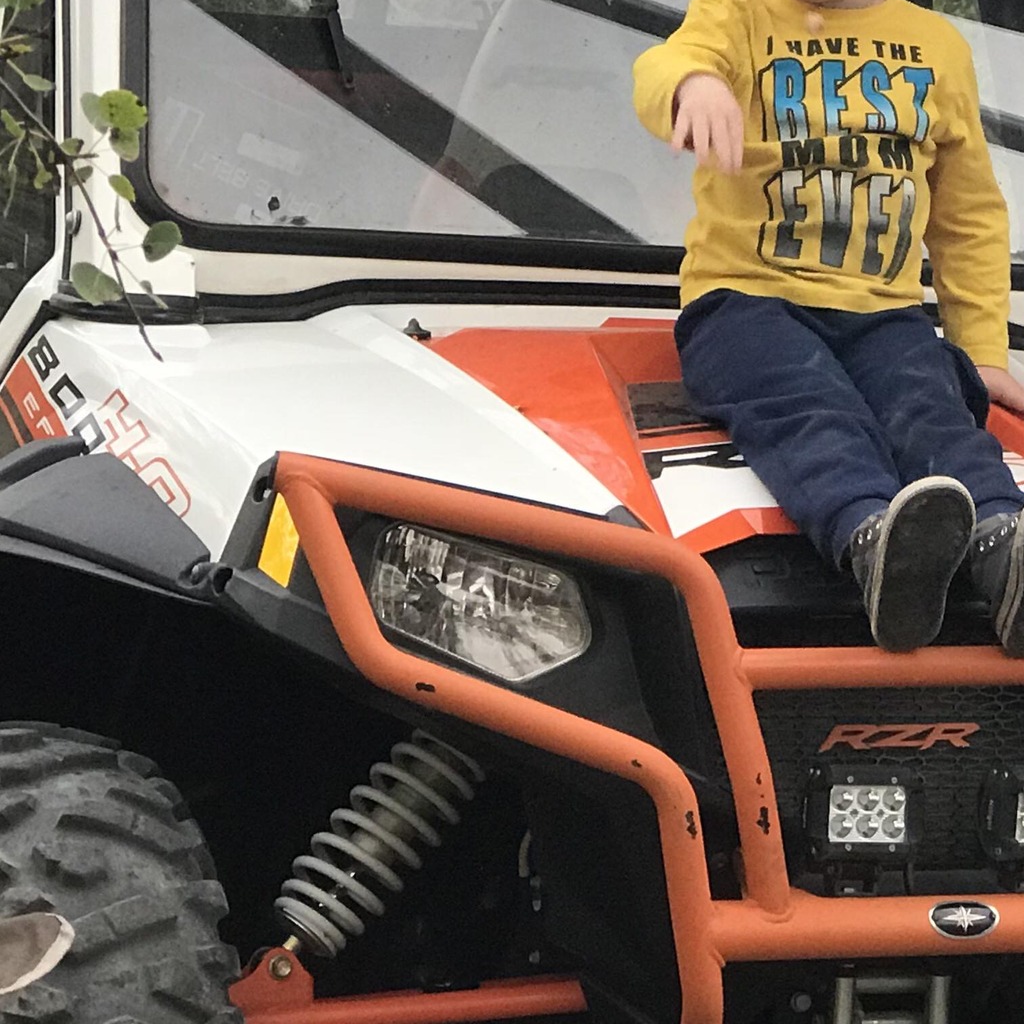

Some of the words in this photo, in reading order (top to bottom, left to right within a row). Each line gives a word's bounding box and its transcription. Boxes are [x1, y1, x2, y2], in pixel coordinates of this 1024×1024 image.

[767, 35, 774, 56] I
[785, 37, 860, 57] HAVE
[872, 39, 924, 64] THE
[758, 57, 936, 143] BEST
[780, 135, 915, 172] MOM
[818, 722, 981, 753] RZR
